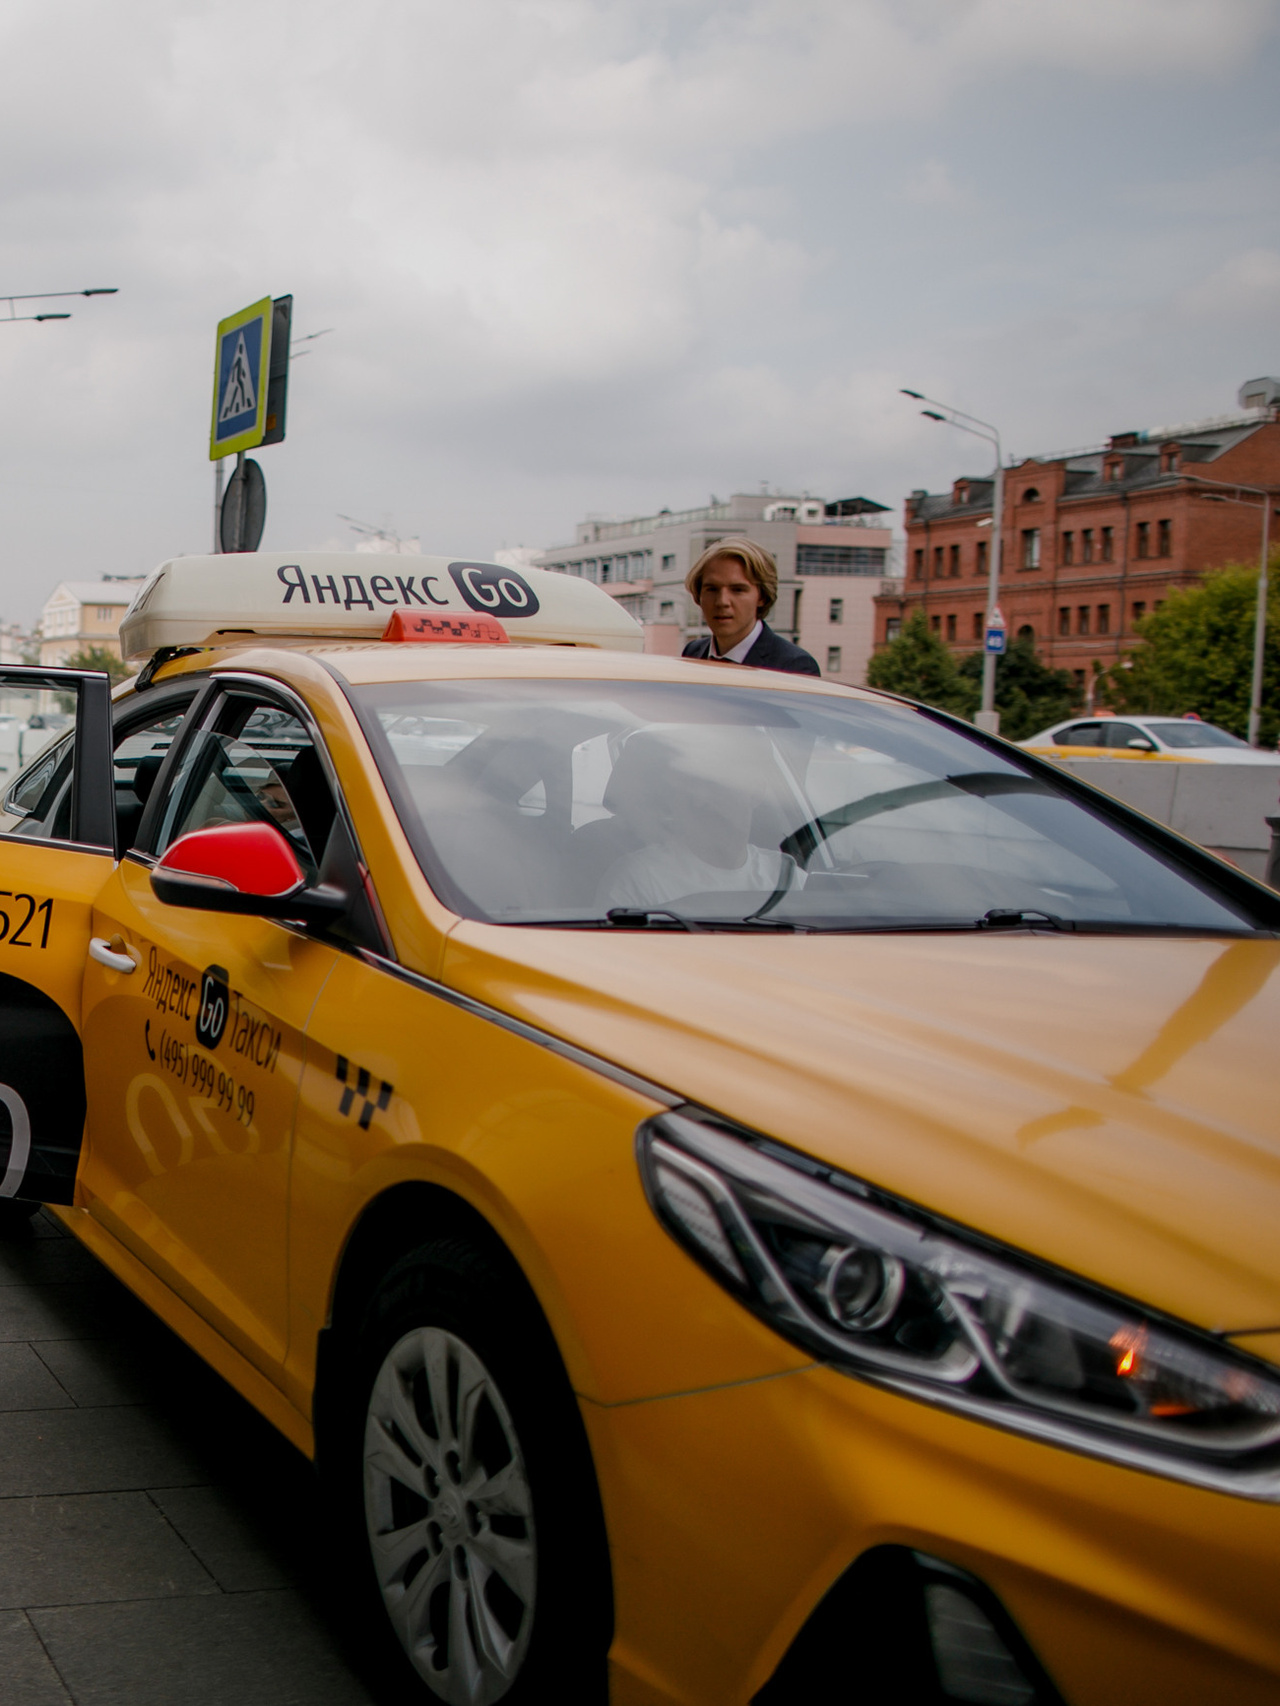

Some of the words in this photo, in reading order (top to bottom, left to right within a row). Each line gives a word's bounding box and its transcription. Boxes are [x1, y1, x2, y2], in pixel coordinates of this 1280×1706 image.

[277, 565, 449, 611] Яндекс
[462, 568, 528, 608] Go
[142, 945, 197, 1021] Яндекс
[199, 976, 225, 1038] Go
[229, 990, 282, 1074] Такси
[160, 1028, 189, 1085] (495)
[192, 1053, 215, 1099] 999
[218, 1072, 234, 1113] 99
[237, 1085, 255, 1128] 99
